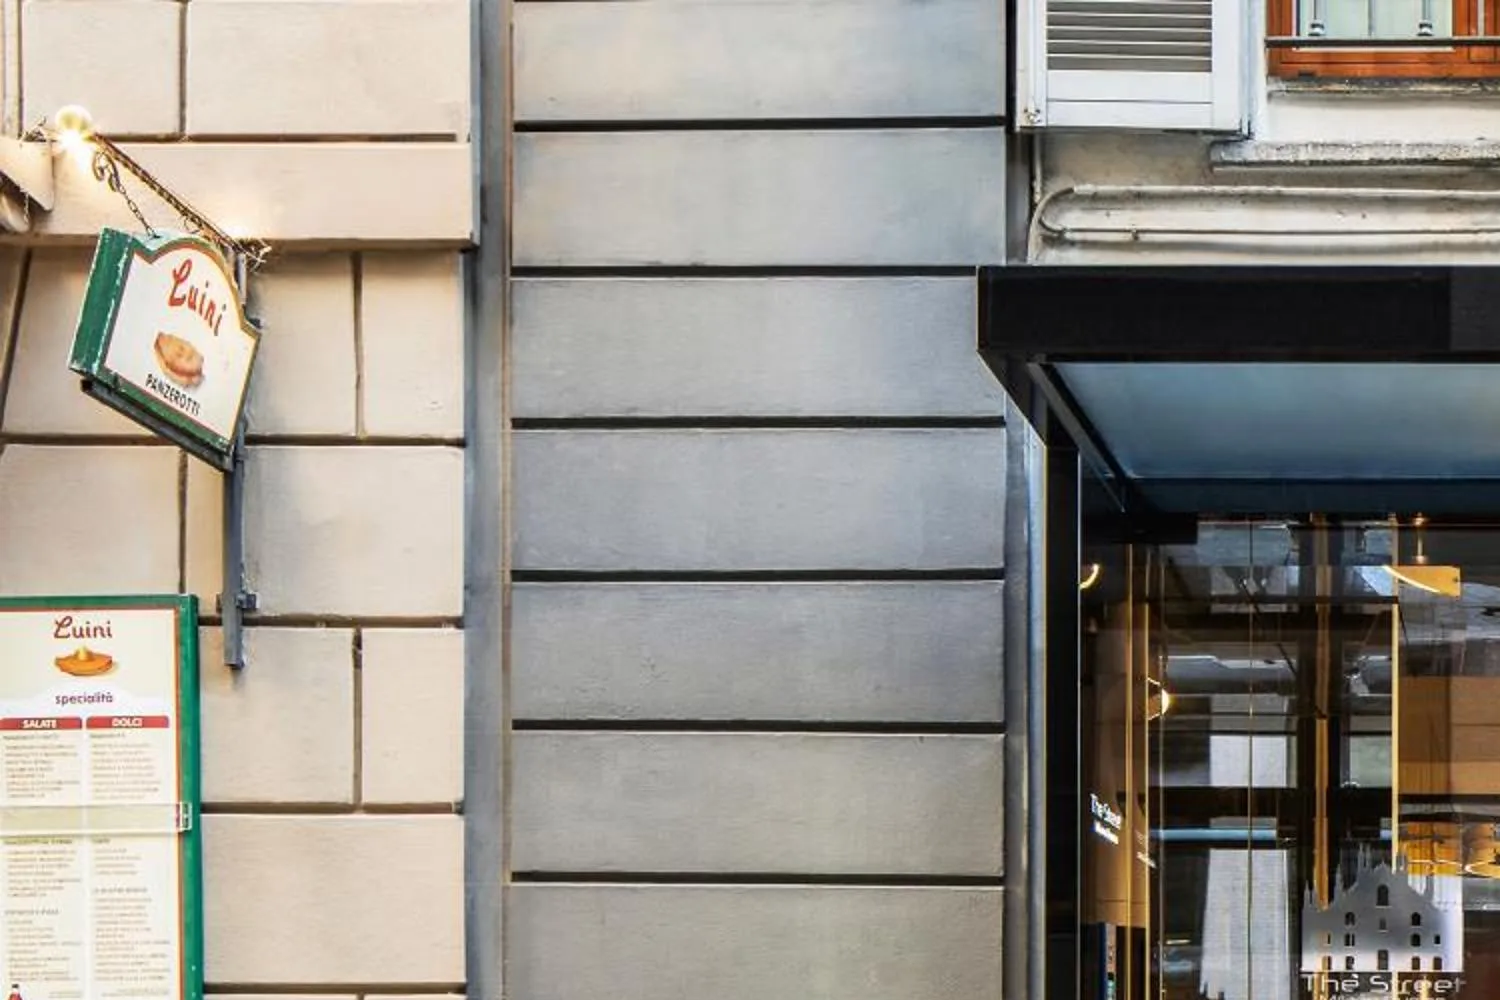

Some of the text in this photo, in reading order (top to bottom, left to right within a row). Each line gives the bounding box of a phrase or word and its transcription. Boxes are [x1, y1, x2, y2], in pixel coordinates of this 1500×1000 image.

[168, 259, 227, 337] Luini
[145, 373, 201, 416] PANZEROTTI
[53, 616, 113, 639] Luini
[111, 717, 142, 727] DOLCI
[1301, 973, 1359, 993] The
